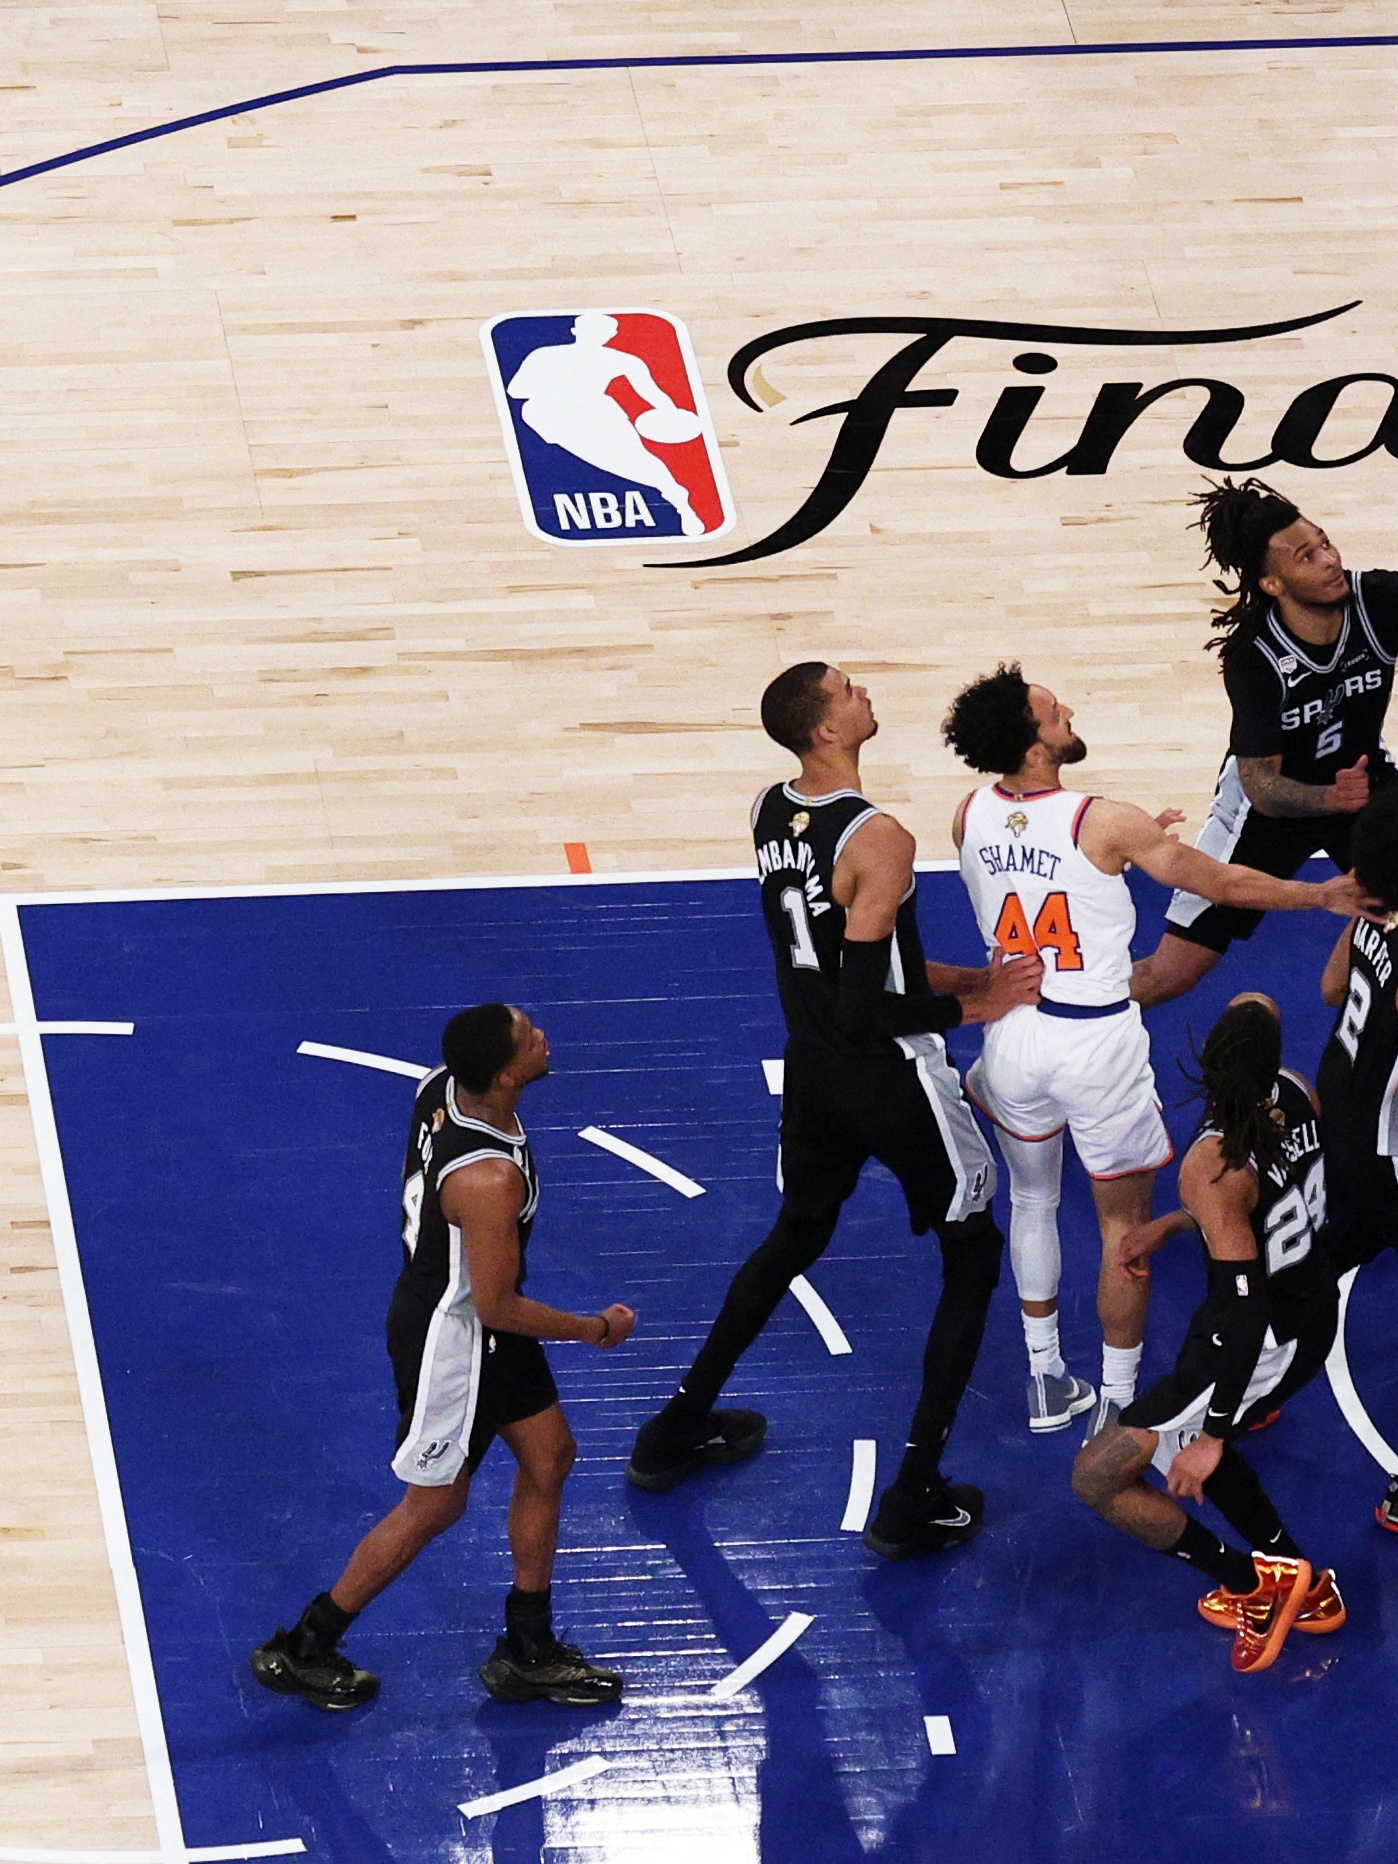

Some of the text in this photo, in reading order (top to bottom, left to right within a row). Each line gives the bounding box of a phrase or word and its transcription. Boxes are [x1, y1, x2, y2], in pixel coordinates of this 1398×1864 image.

[553, 490, 657, 531] NBA
[1315, 720, 1343, 759] 5
[979, 843, 1062, 881] SHAMET
[780, 886, 821, 972] 1
[993, 891, 1084, 972] 44
[1335, 966, 1372, 1068] 2
[1264, 1153, 1328, 1277] 24
